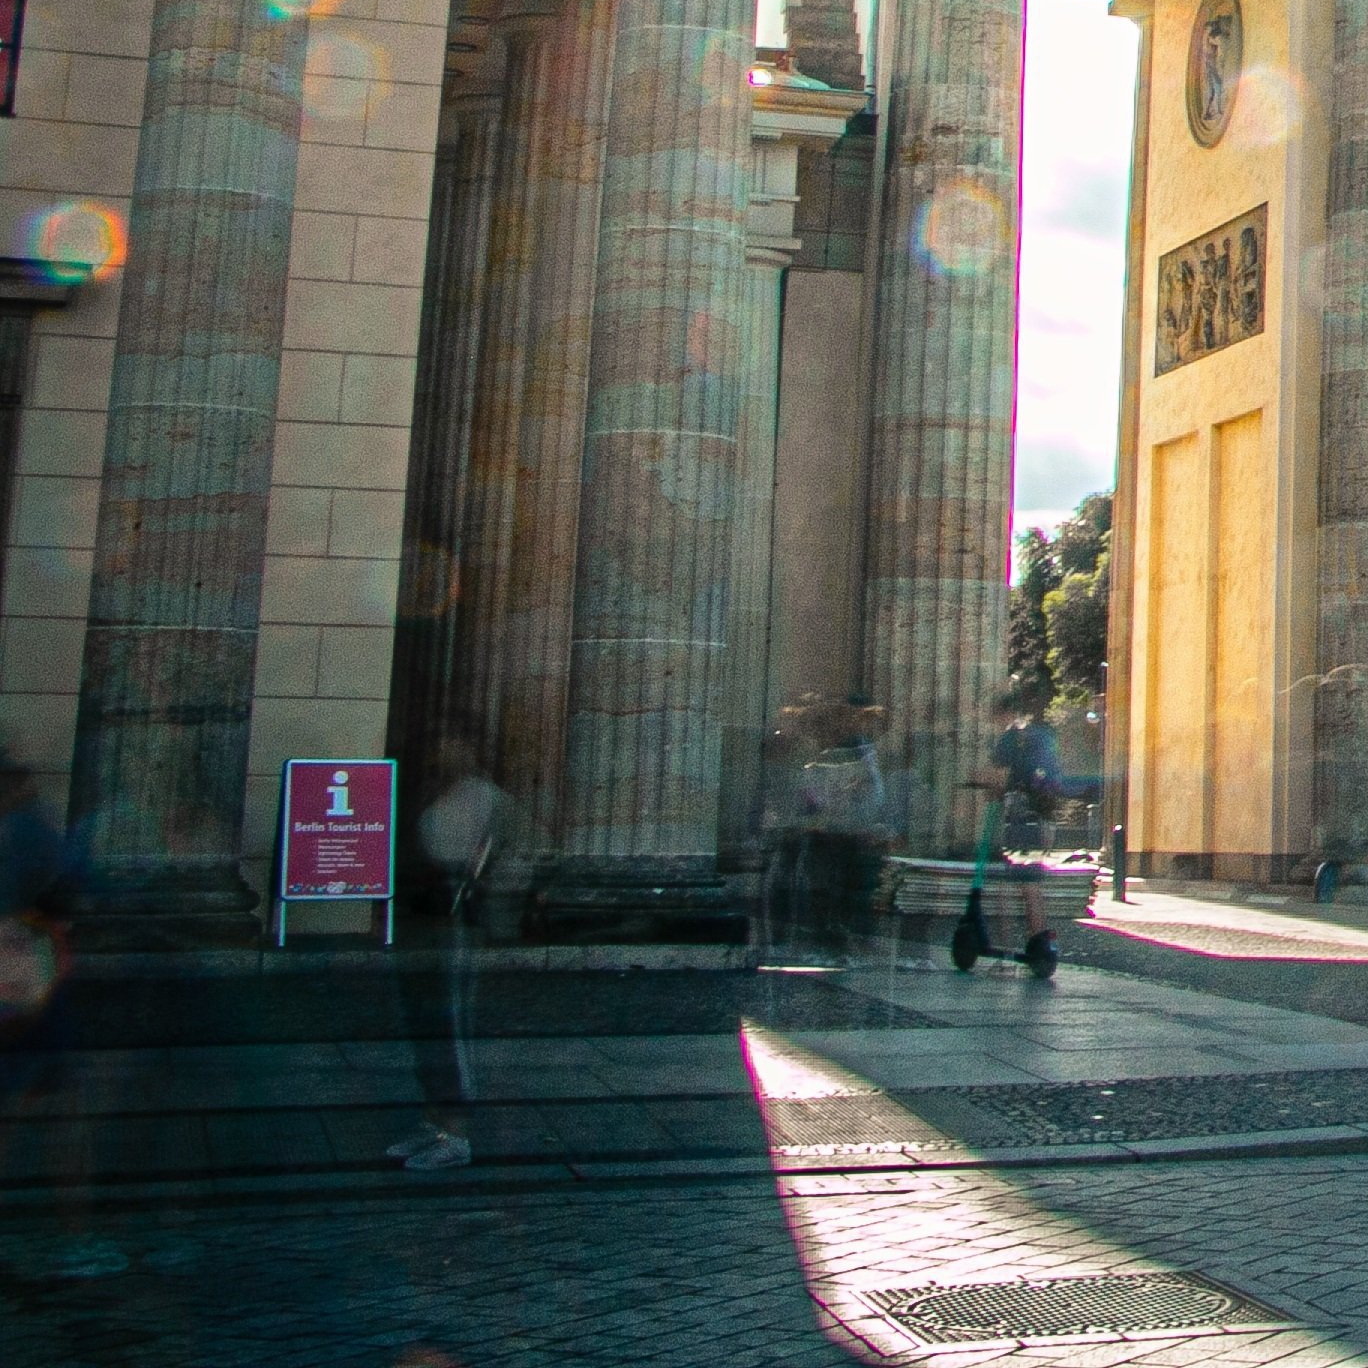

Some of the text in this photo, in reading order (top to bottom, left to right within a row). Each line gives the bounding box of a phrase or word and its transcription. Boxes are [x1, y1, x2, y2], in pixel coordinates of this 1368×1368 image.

[294, 821, 385, 832] Berlin Tourist Info
